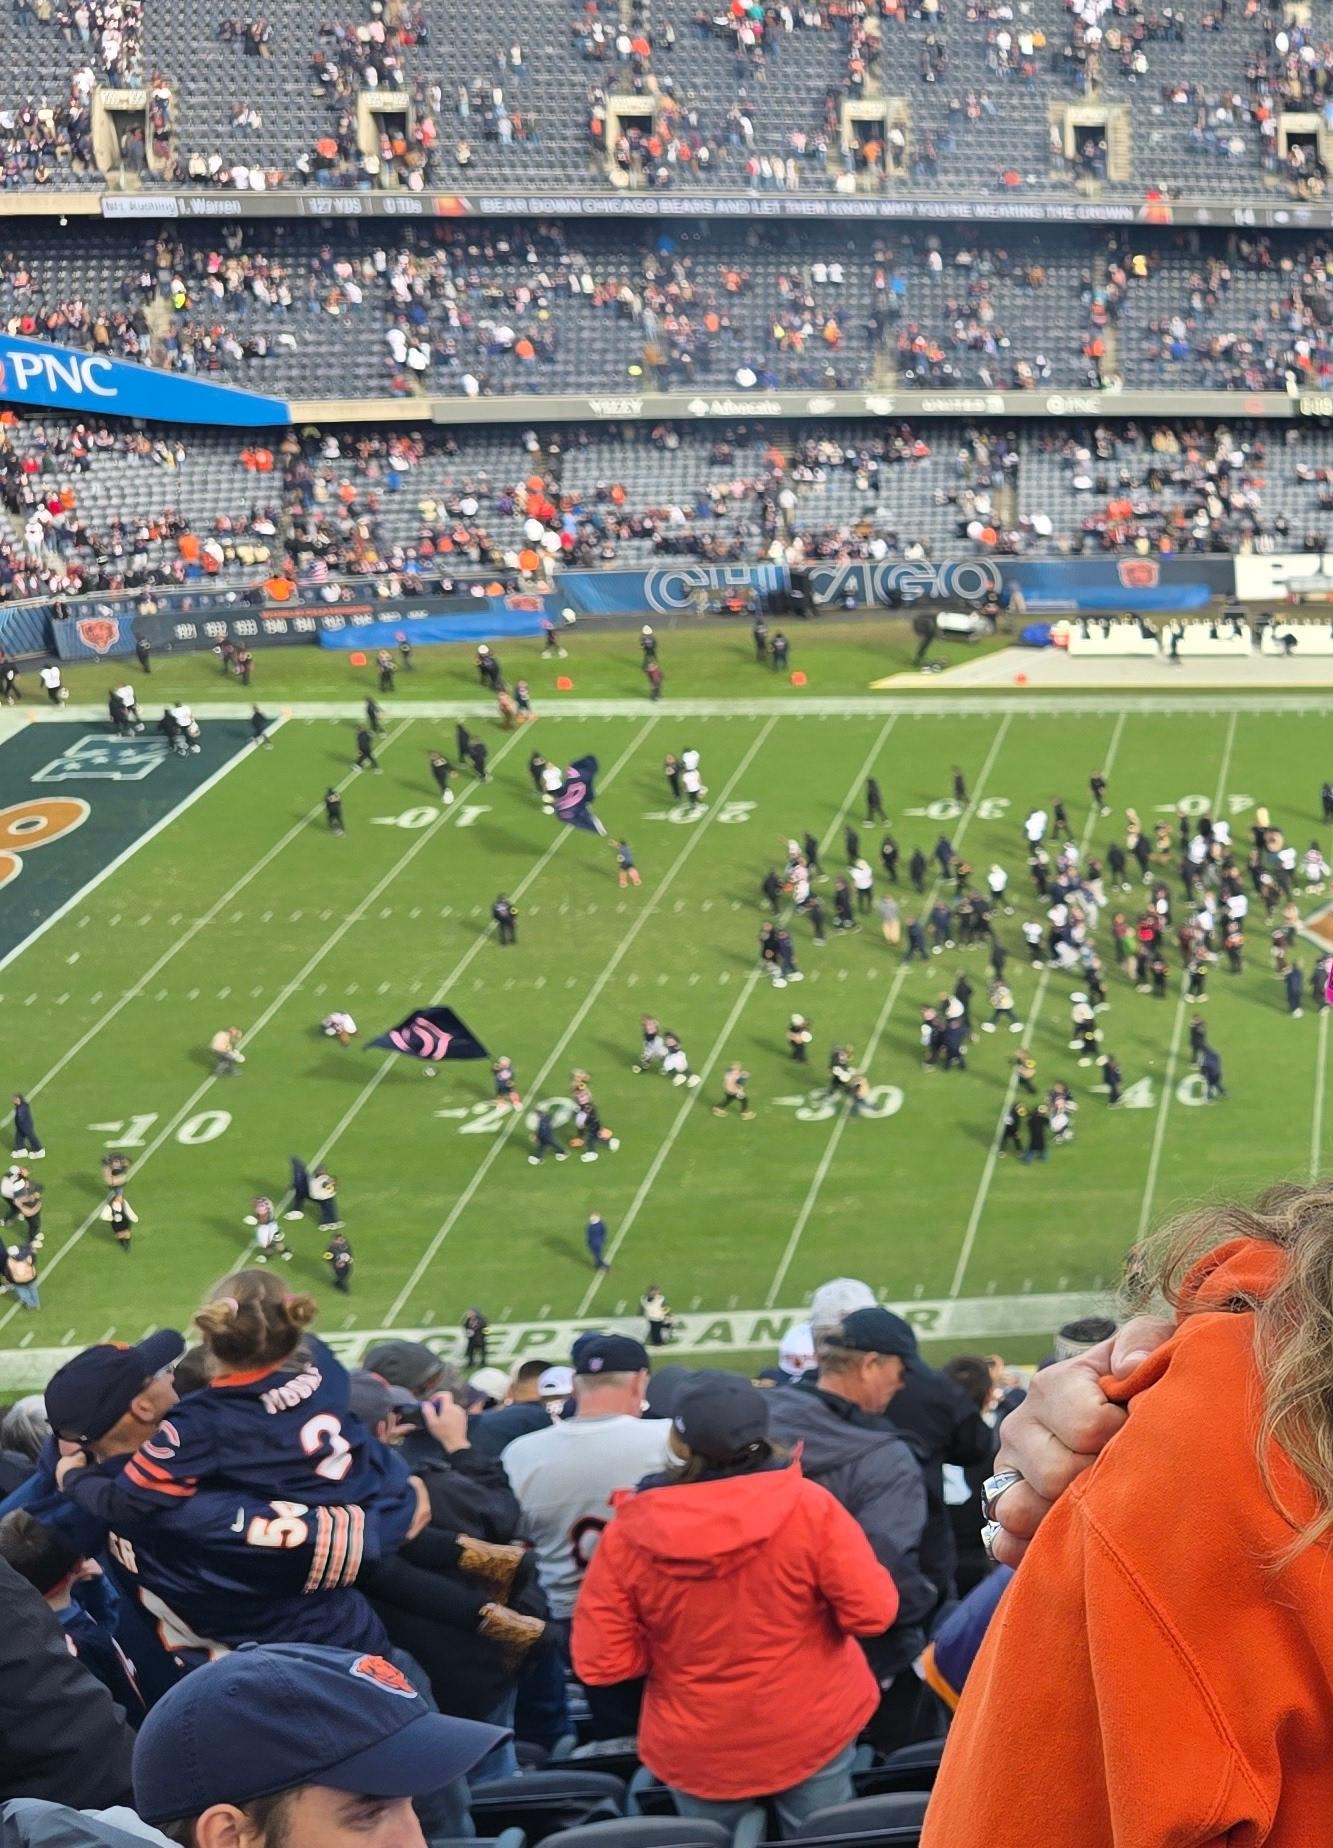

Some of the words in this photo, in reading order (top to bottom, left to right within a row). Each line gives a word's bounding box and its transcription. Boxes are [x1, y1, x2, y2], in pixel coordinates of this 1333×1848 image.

[191, 199, 241, 214] Warren
[480, 199, 527, 213] BEAR
[528, 199, 581, 213] DOWN
[582, 199, 657, 213] CHICAGO
[659, 199, 713, 213] BEARS
[714, 199, 750, 214] AND
[751, 199, 781, 214] LET
[783, 200, 827, 214] THEM
[830, 200, 877, 215] KNOW
[7, 352, 118, 397] PNC
[103, 1110, 233, 1149] 10
[300, 1413, 353, 1481] 2
